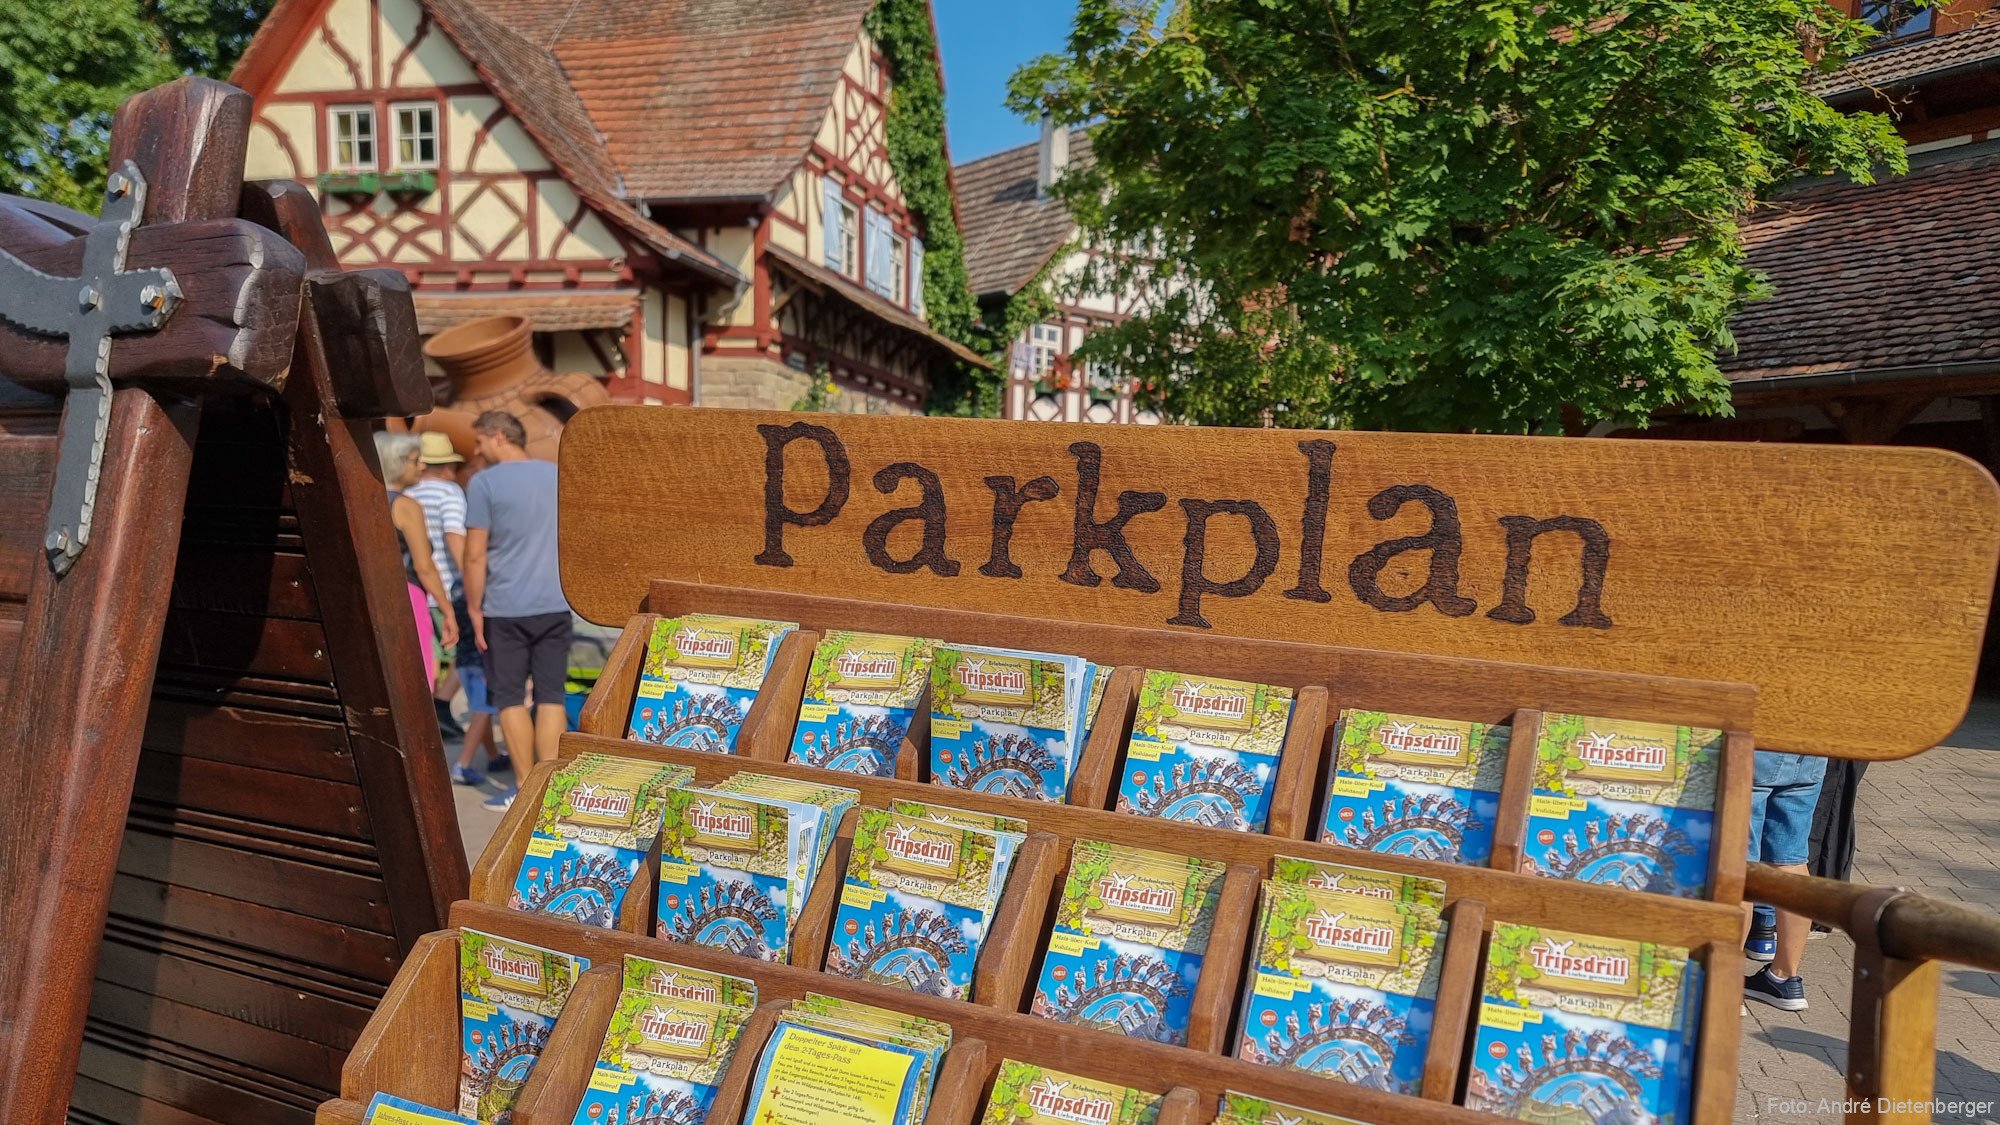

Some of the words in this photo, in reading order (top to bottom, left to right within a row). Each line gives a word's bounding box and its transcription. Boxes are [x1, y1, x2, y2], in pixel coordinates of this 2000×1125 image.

[755, 421, 1613, 629] Parkplan
[677, 635, 733, 655] Tripsdrill
[688, 670, 720, 679] Parkplan
[838, 657, 895, 676] Tripsdrill
[958, 667, 1023, 690] Tripsdrill
[851, 692, 884, 700] Parkplan
[1173, 690, 1244, 713] Tripsdrill
[981, 707, 1018, 717] Parkplan
[1190, 730, 1231, 741] Parkplan
[1381, 729, 1458, 750] Tripsdrill
[1578, 741, 1663, 765] Tripsdrill
[1401, 767, 1445, 778] Parkplan
[1603, 784, 1651, 795] Parkplan
[572, 791, 629, 812] Tripsdrill
[690, 809, 750, 833] Tripsdrill
[580, 828, 613, 838] Parkplan
[886, 832, 952, 861] Tripsdrill
[710, 851, 744, 863] Parkplan
[900, 877, 938, 891] Parkplan
[1101, 882, 1174, 907] Tripsdrill
[1115, 924, 1158, 937] Parkplan
[1307, 920, 1390, 947] Tripsdrill
[484, 952, 539, 978] Tripsdrill
[1532, 948, 1625, 977] Tripsdrill
[1328, 966, 1376, 980] Parkplan
[505, 992, 536, 1005] Parkplan
[1560, 995, 1613, 1010] Parkplan
[643, 1015, 707, 1040] Tripsdrill
[784, 1043, 800, 1051] dem
[801, 1046, 852, 1064] 2-Tages-Pass
[789, 1033, 827, 1047] Doppelter
[827, 1041, 848, 1052] Spaß
[848, 1047, 862, 1055] mit
[651, 1059, 689, 1071] Parkplan
[1032, 1087, 1111, 1121] Tripsdrill
